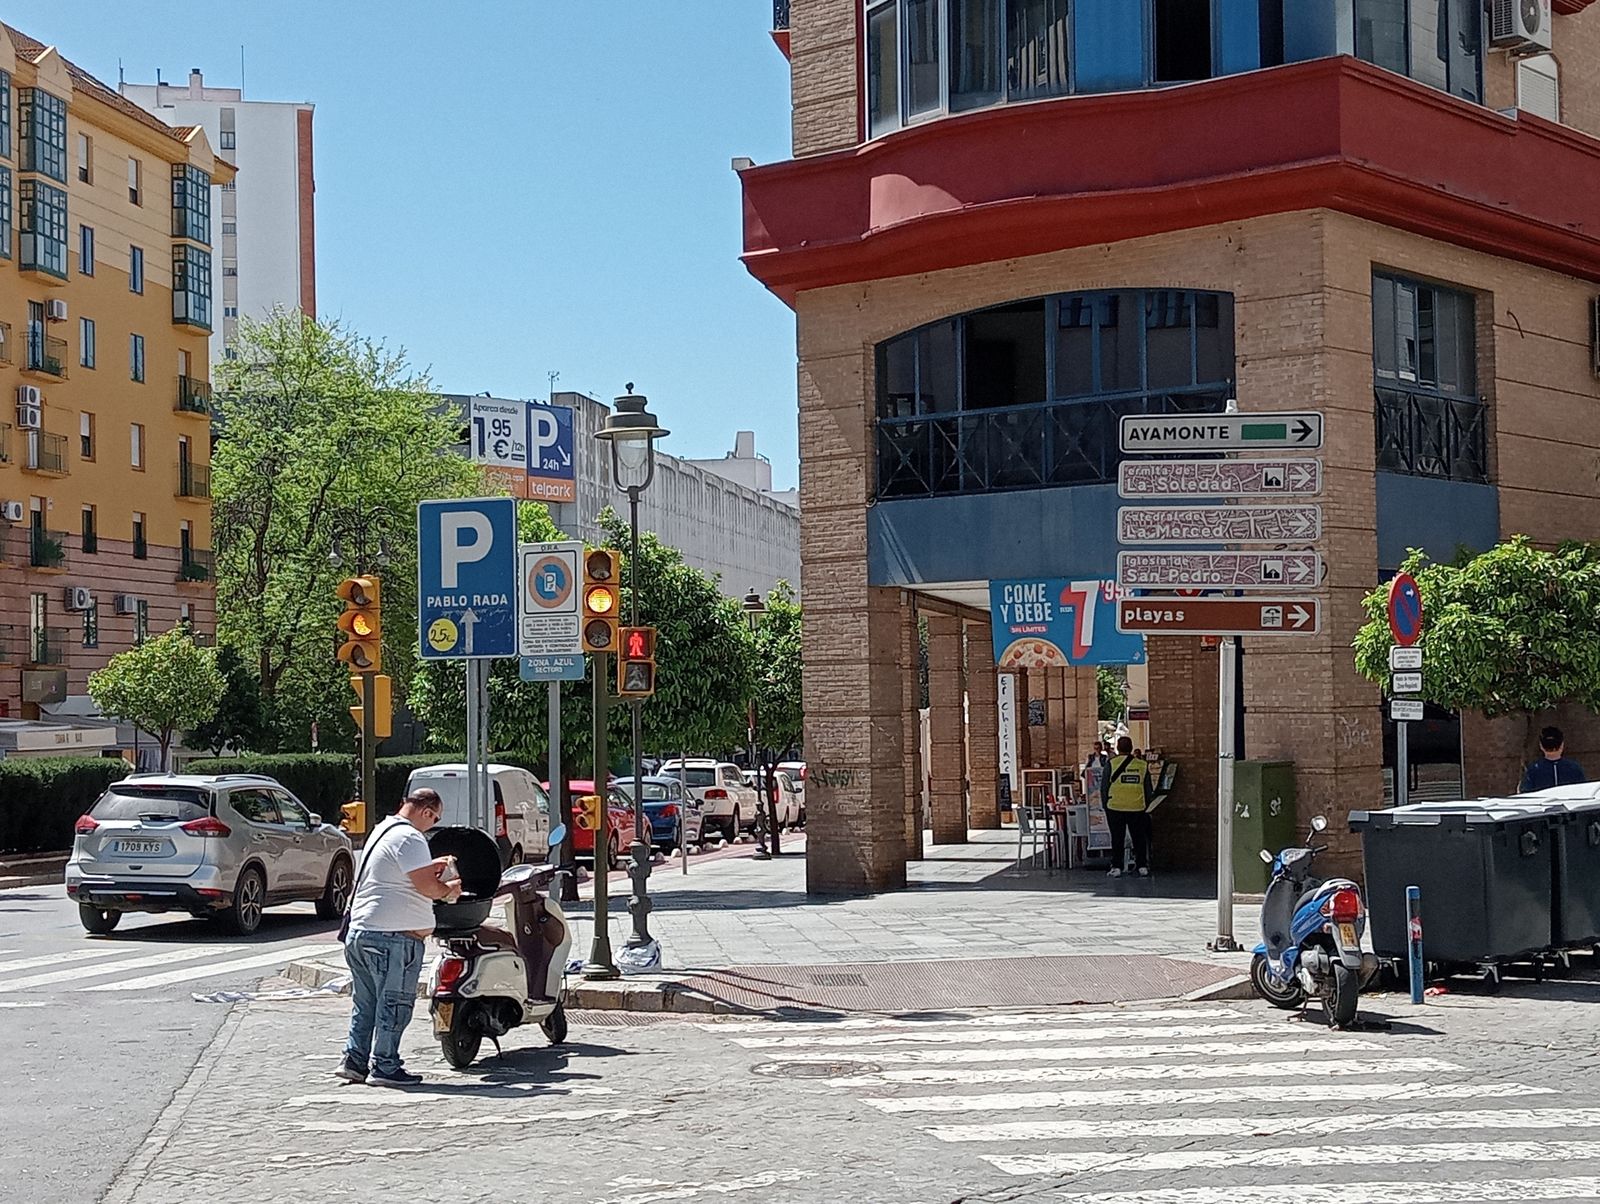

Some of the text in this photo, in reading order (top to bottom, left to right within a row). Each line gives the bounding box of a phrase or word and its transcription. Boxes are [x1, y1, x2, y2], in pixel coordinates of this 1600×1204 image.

[473, 403, 519, 415] Aparca desde
[530, 408, 559, 469] P
[1128, 426, 1230, 441] AYAMONTE
[543, 459, 560, 471] 24h
[1128, 466, 1190, 476] ermita de
[532, 482, 571, 498] telpark
[1127, 477, 1232, 491] La Soledad
[1184, 512, 1200, 521] de
[1126, 524, 1223, 538] La Merced
[440, 511, 494, 589] P
[1173, 556, 1188, 566] de
[1126, 569, 1221, 582] San Pedro
[427, 594, 508, 608] PABLO RADA
[1004, 584, 1047, 604] COME
[1000, 602, 1053, 624] Y BEBE
[1124, 608, 1185, 624] playas
[527, 657, 575, 668] ZONA AZUL
